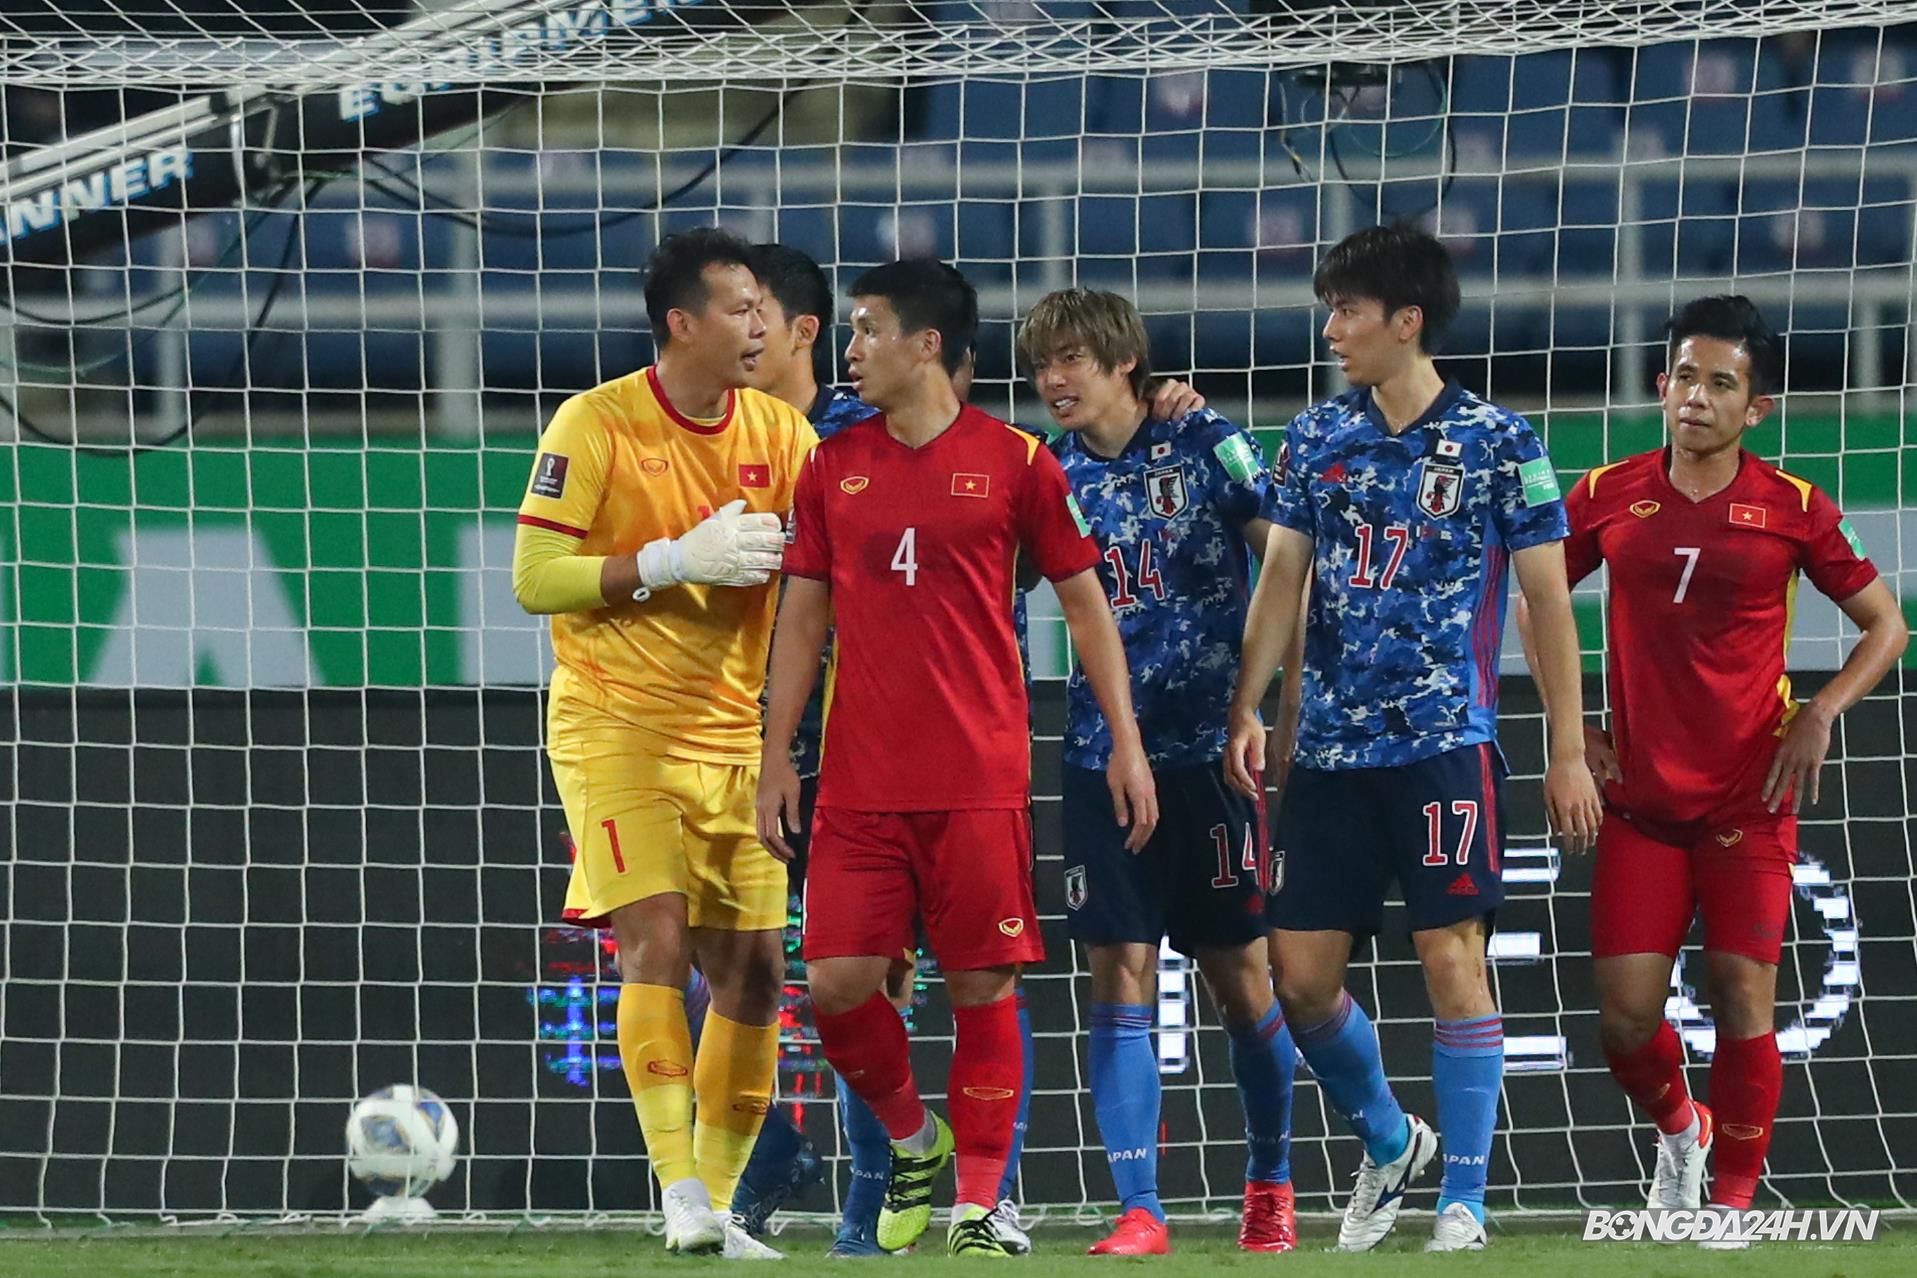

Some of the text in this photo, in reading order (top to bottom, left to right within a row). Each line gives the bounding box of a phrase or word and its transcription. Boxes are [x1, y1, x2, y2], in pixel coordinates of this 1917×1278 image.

[890, 527, 919, 586] 4
[1104, 538, 1165, 608] 14
[1349, 523, 1409, 589] 17
[1673, 547, 1701, 604] 7
[601, 818, 626, 874] 1
[1423, 800, 1478, 867] 17
